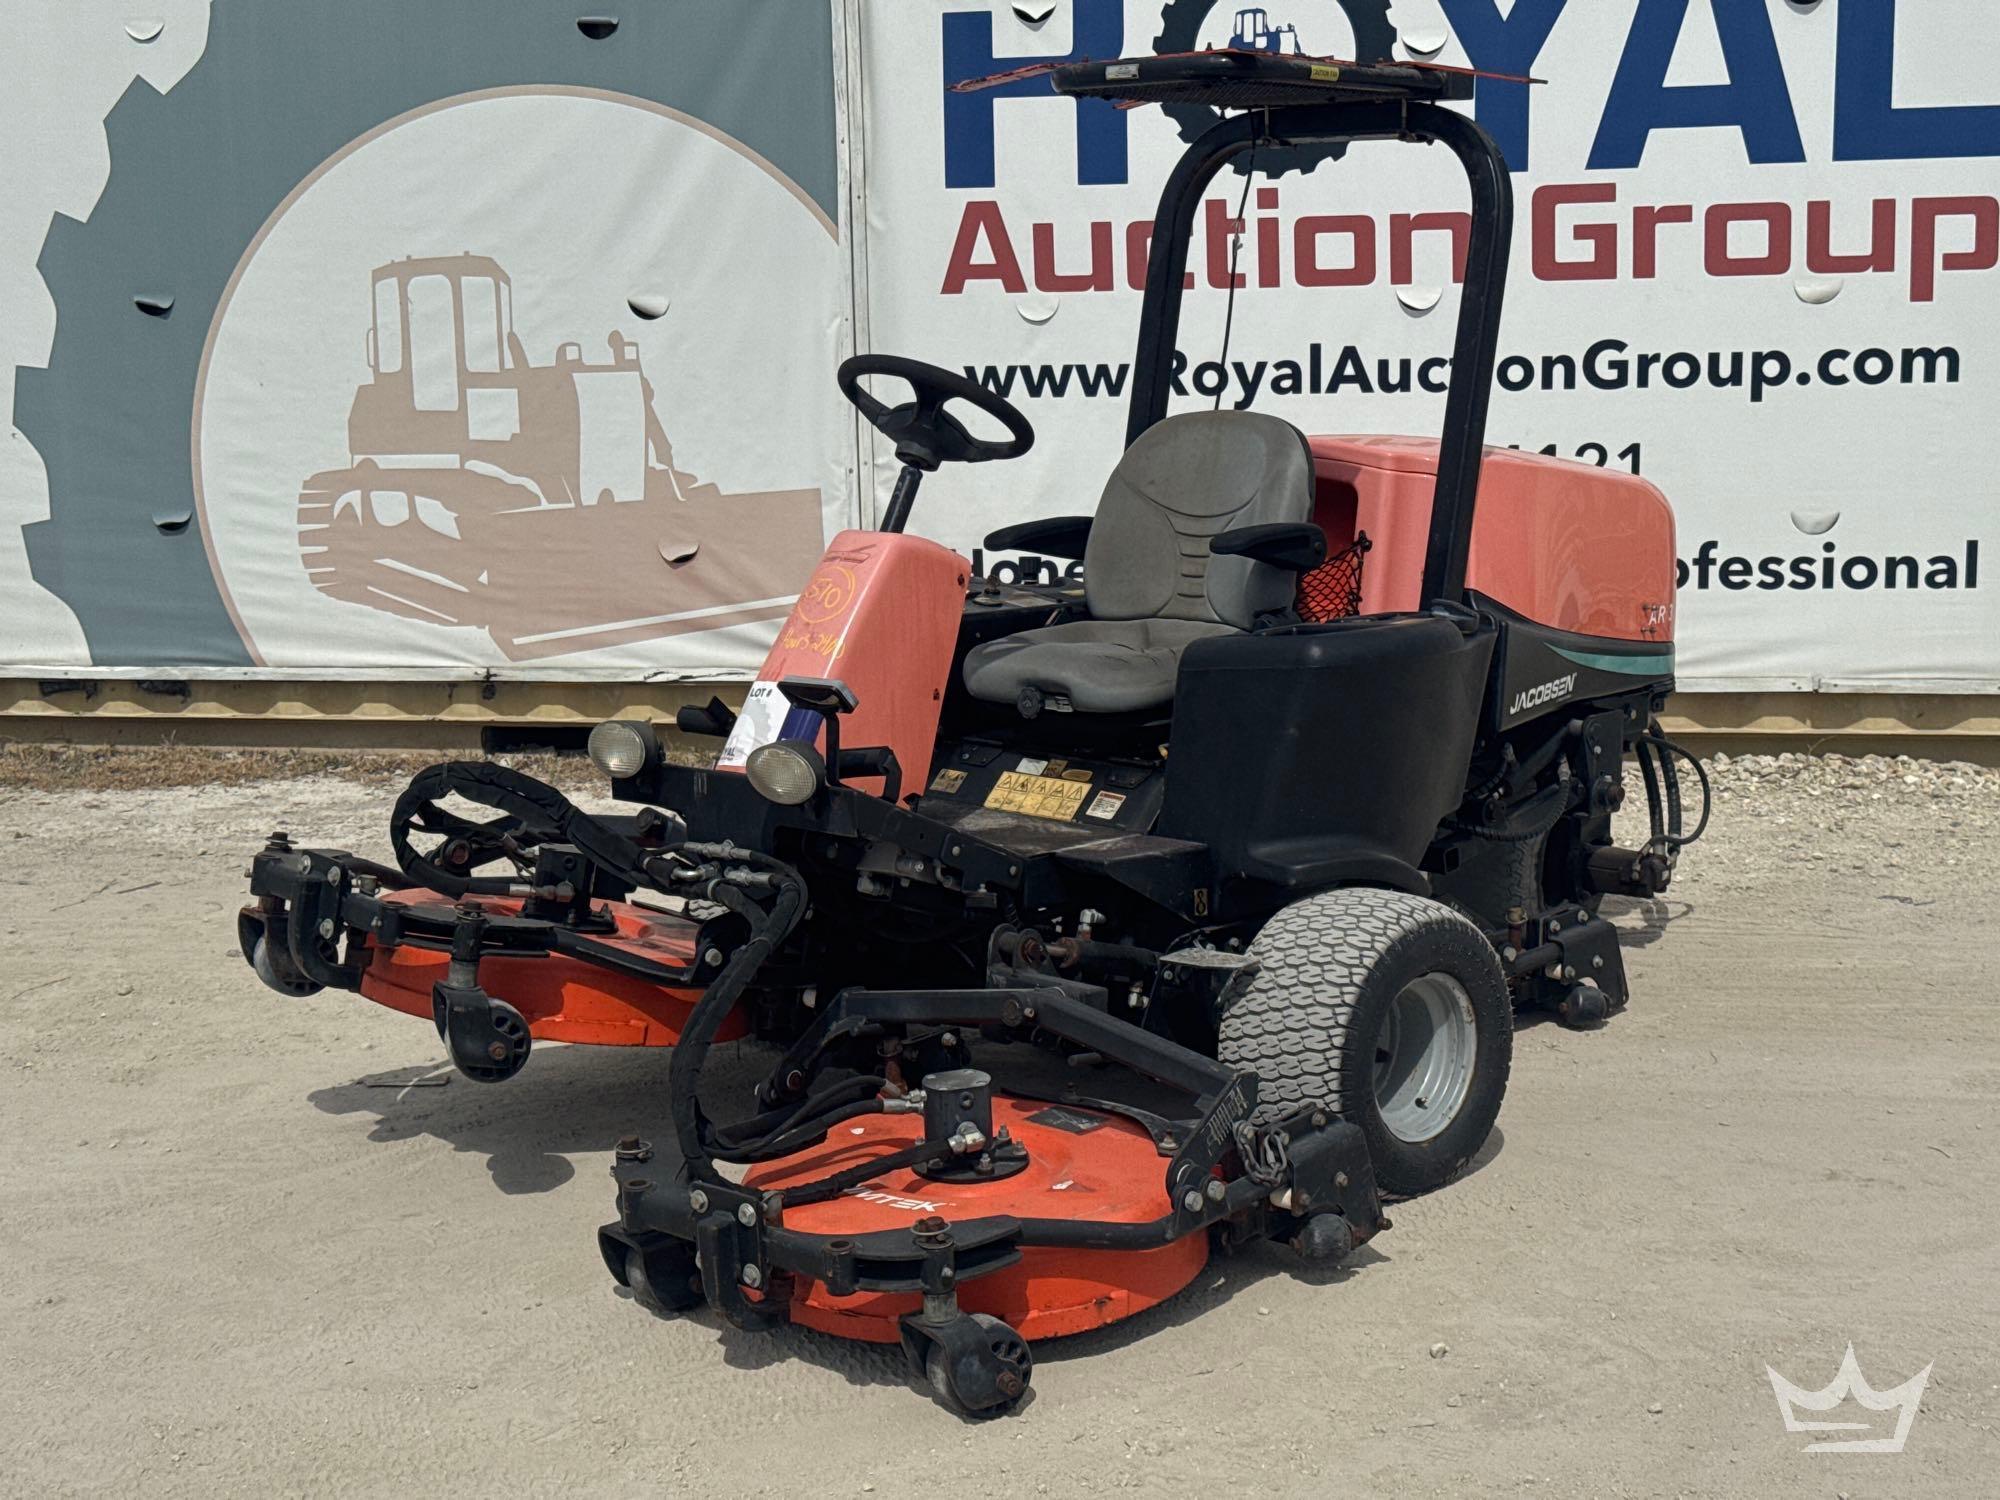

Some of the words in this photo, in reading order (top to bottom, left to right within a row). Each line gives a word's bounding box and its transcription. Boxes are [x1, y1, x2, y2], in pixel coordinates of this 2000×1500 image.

[1531, 183, 1998, 302] Group
[962, 338, 1961, 410] wwwRoyalAuconGroup.com
[1675, 540, 1979, 591] fessional
[750, 688, 767, 698] LOT
[1509, 672, 1577, 715] JACOBSEN
